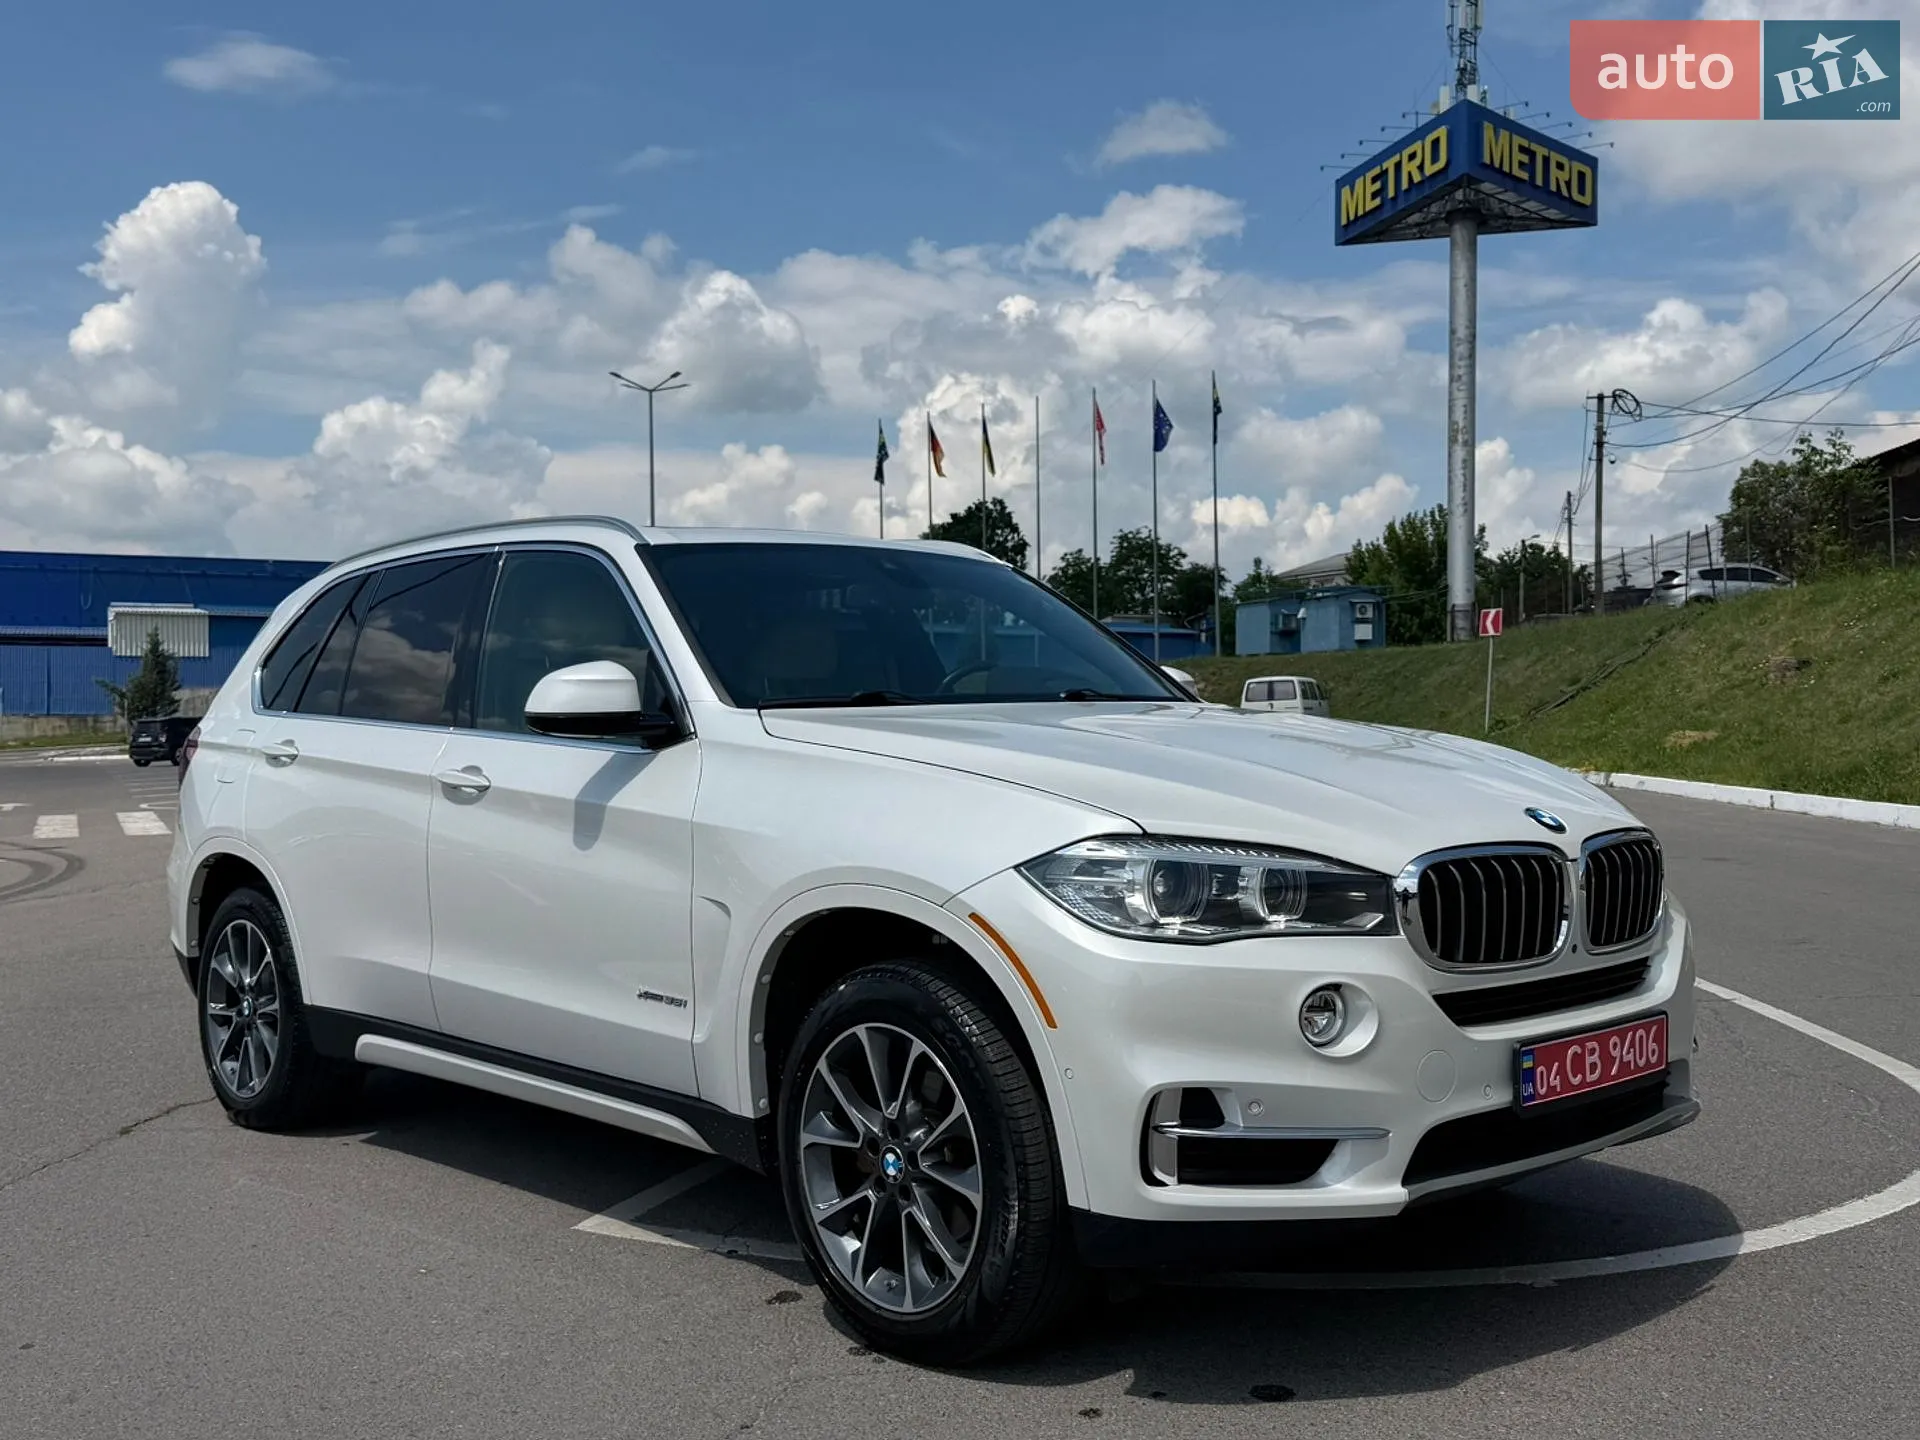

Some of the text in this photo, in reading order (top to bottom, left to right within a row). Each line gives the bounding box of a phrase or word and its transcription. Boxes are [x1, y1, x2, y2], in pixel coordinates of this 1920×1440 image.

[1341, 126, 1448, 226] METRO
[1483, 121, 1593, 206] METRO
[1522, 1084, 1535, 1096] UA
[1536, 1025, 1659, 1096] 04 CB 9406
